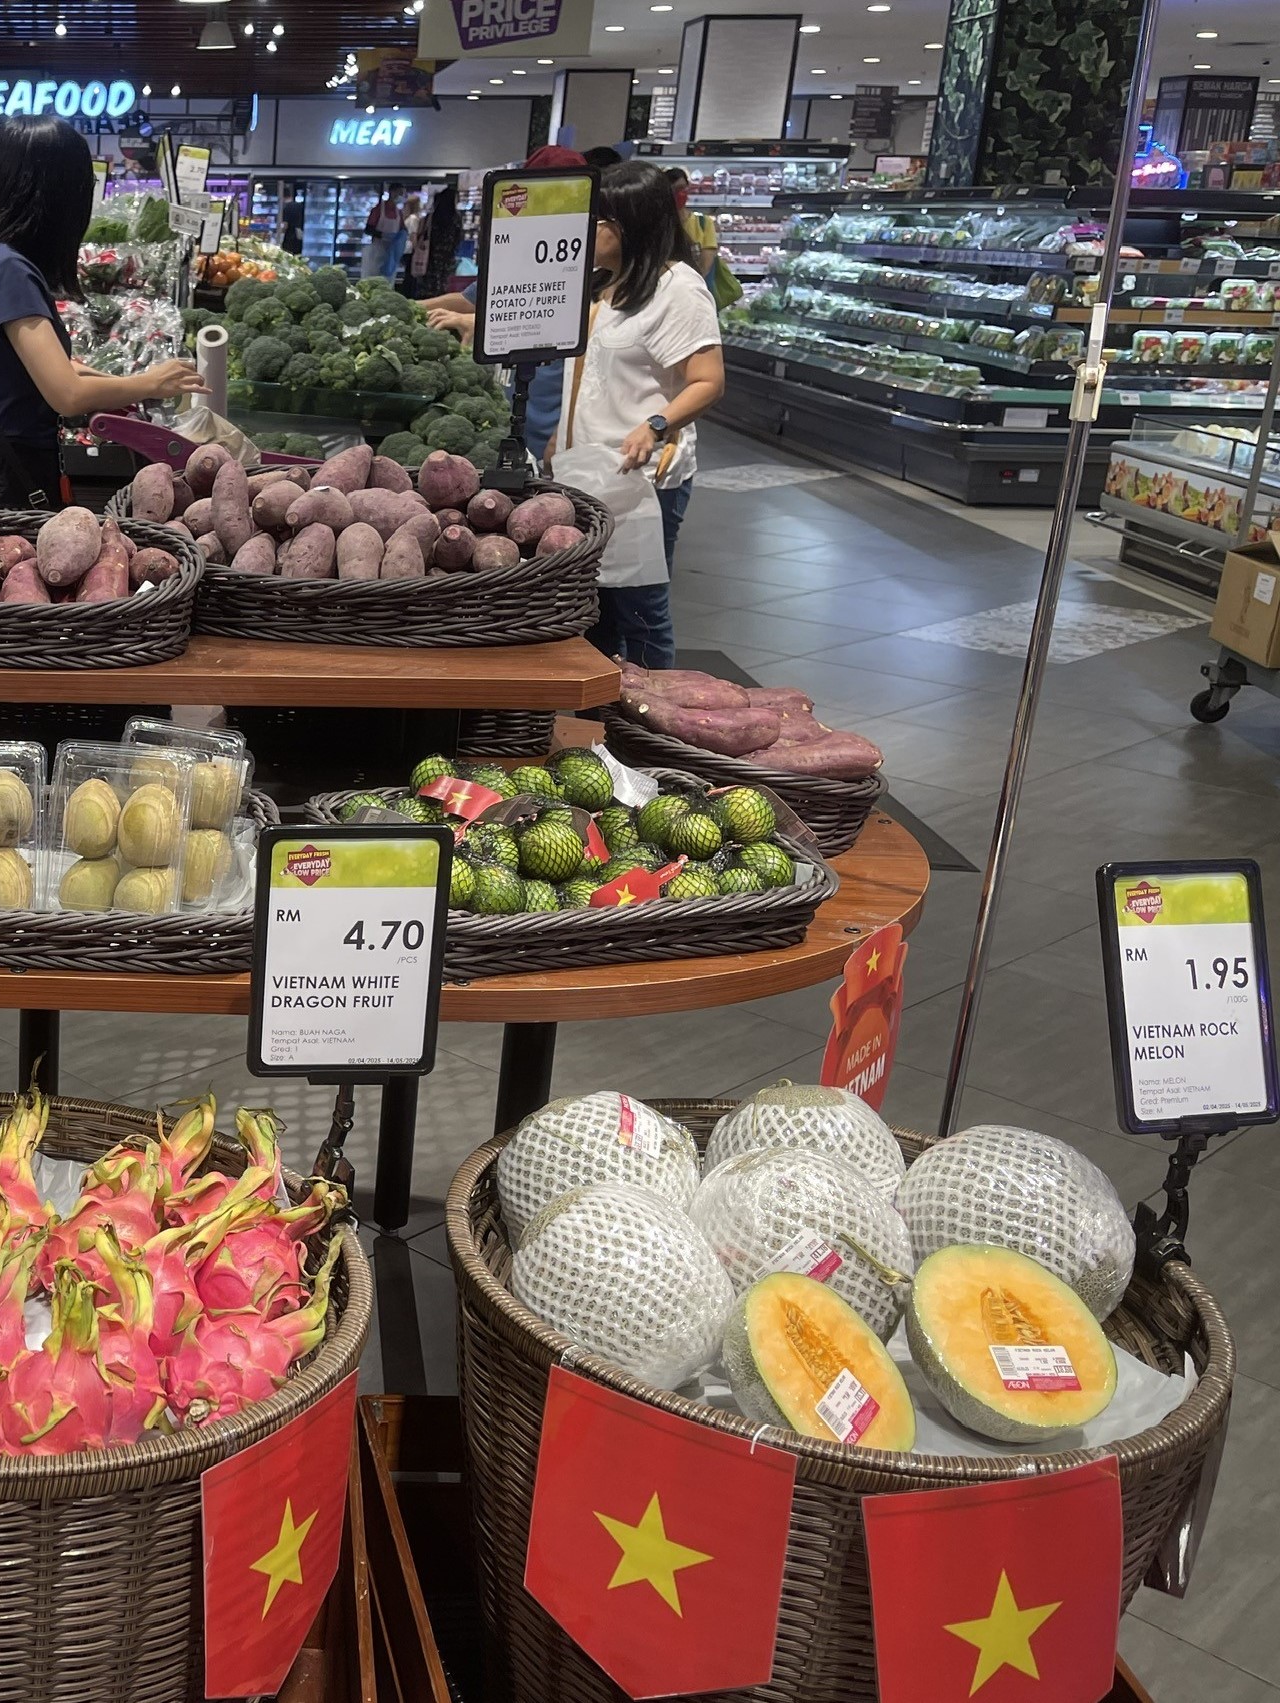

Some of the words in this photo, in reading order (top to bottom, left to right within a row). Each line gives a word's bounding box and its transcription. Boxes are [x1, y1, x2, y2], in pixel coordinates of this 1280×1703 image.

[461, 0, 556, 28] PRICE
[469, 18, 550, 42] PRIVILEGE
[330, 118, 413, 146] MEAT
[494, 234, 510, 244] RM
[535, 238, 582, 264] 0.89
[491, 283, 537, 296] JAPANESE
[539, 281, 566, 292] SWEET
[490, 298, 527, 309] POTATO
[536, 295, 567, 306] PURPLE
[489, 312, 517, 322] SWEET
[519, 309, 555, 320] POTATO
[288, 852, 312, 861] EVERYDAY
[313, 851, 330, 859] FRESH
[293, 858, 331, 870] EVERYDAY
[294, 869, 309, 877] LOW
[1131, 896, 1163, 908] EVERYDAY
[276, 909, 301, 922] RM
[343, 920, 425, 950] 4.70
[396, 956, 418, 964] /PCS
[1125, 948, 1148, 961] RM
[1185, 957, 1249, 990] 1.95
[272, 976, 346, 989] VIETNAM
[352, 975, 400, 989] WHITE
[271, 995, 346, 1008] DRAGON
[353, 995, 394, 1008] FRUIT
[1226, 995, 1248, 1004] /100G
[1133, 1024, 1196, 1039] VIETNAM
[1200, 1022, 1238, 1036] ROCK
[271, 1037, 300, 1045] Tempat
[846, 1039, 871, 1074] MADE
[871, 1033, 882, 1050] IN
[1134, 1045, 1185, 1061] MELON
[844, 1053, 886, 1096] ETNAM
[1139, 1078, 1160, 1086] Nama:
[1162, 1077, 1186, 1085] MELON
[1139, 1088, 1164, 1096] Tempat
[1160, 1096, 1189, 1104] Premium
[1008, 1380, 1030, 1389] AEON
